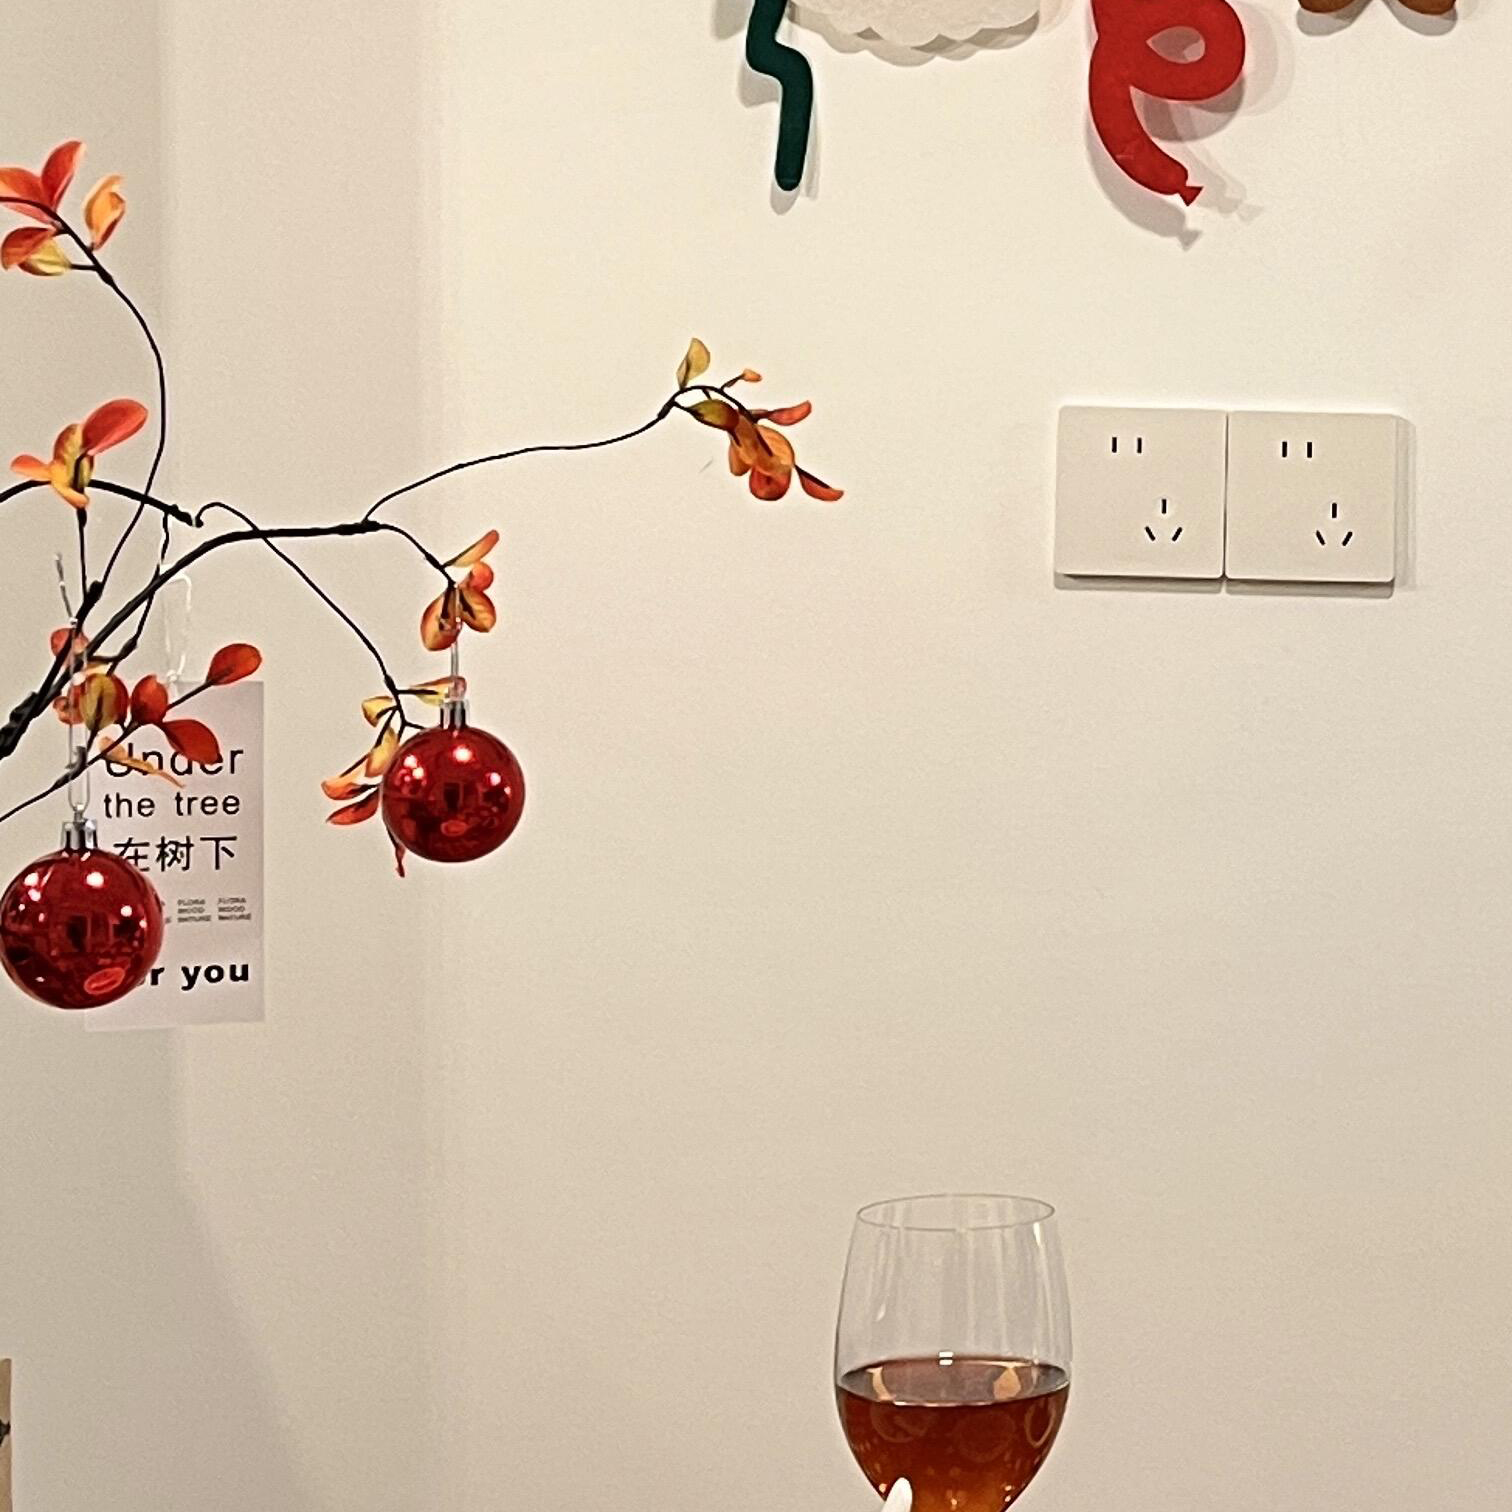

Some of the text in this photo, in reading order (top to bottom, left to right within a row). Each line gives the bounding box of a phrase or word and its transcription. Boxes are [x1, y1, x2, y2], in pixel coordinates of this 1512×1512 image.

[104, 791, 240, 819] the tree
[113, 835, 238, 872] 在树下
[181, 963, 249, 991] you
